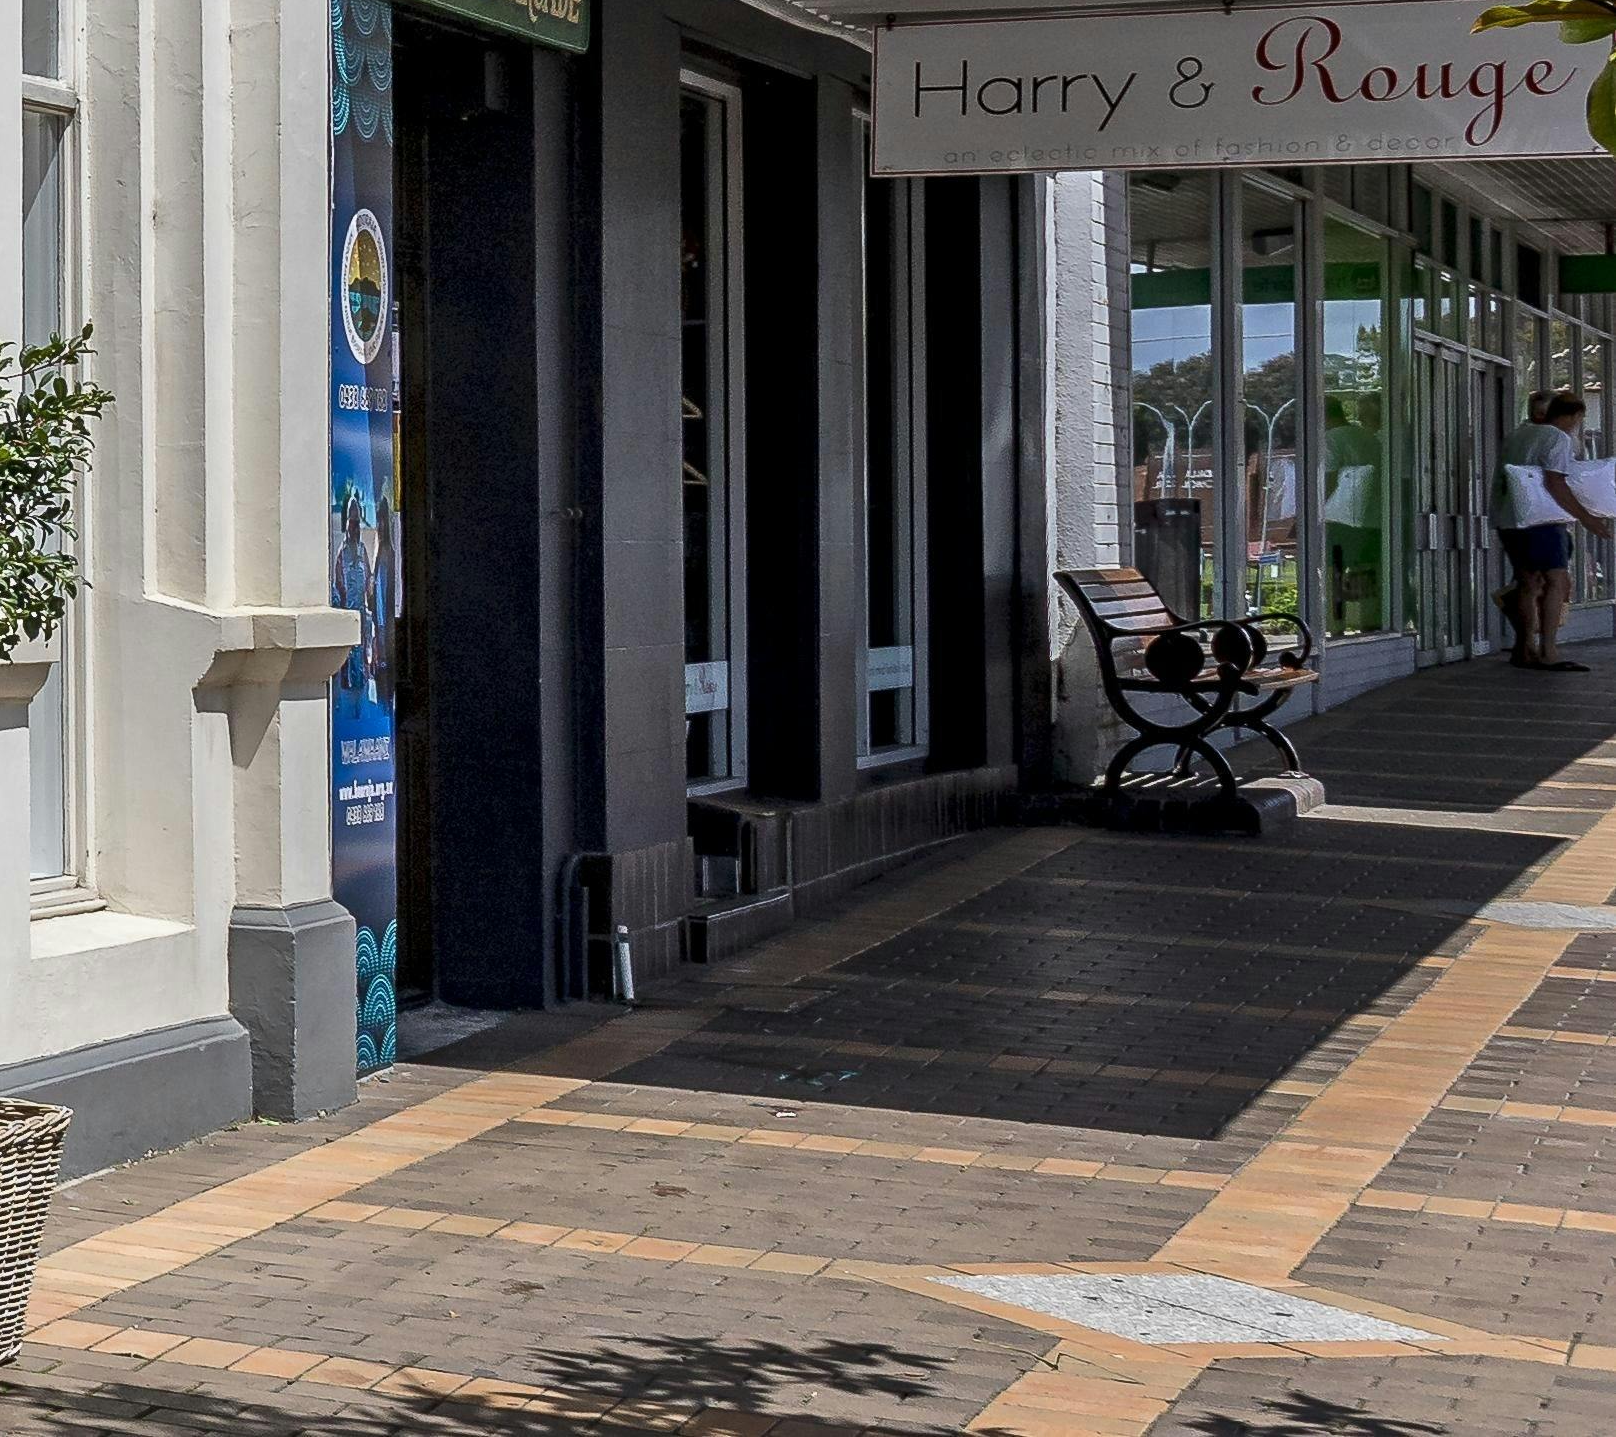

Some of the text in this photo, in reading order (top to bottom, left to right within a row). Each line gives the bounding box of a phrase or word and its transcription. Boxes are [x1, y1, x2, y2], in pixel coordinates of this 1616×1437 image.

[915, 16, 1577, 147] Harry & Rouge
[943, 132, 1455, 164] an eclectic mix of fashion & decor
